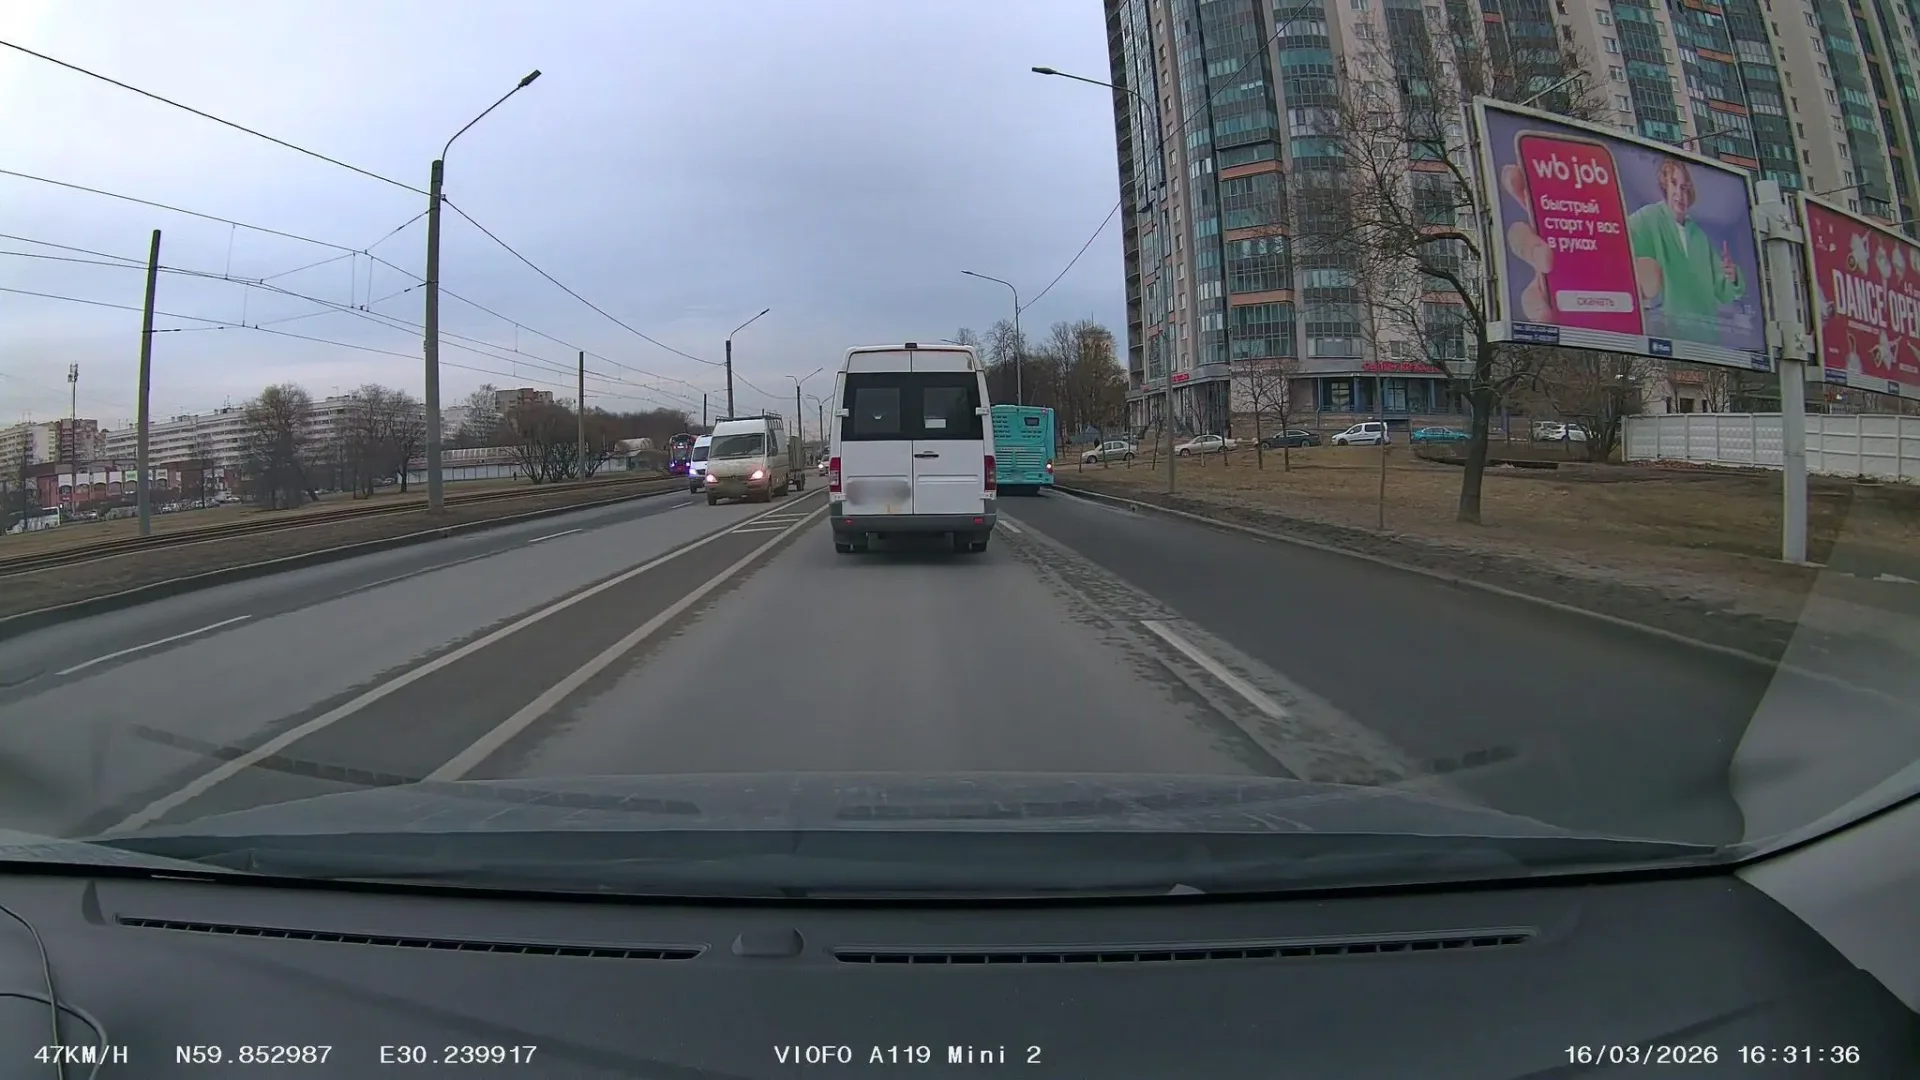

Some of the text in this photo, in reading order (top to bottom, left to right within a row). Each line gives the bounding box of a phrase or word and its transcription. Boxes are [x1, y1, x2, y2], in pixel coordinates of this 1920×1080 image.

[1532, 153, 1609, 189] wb job
[1540, 194, 1600, 216] быстрый
[1544, 217, 1620, 236] старт у вас
[1547, 236, 1598, 253] в руках
[1832, 268, 1888, 328] DANCE
